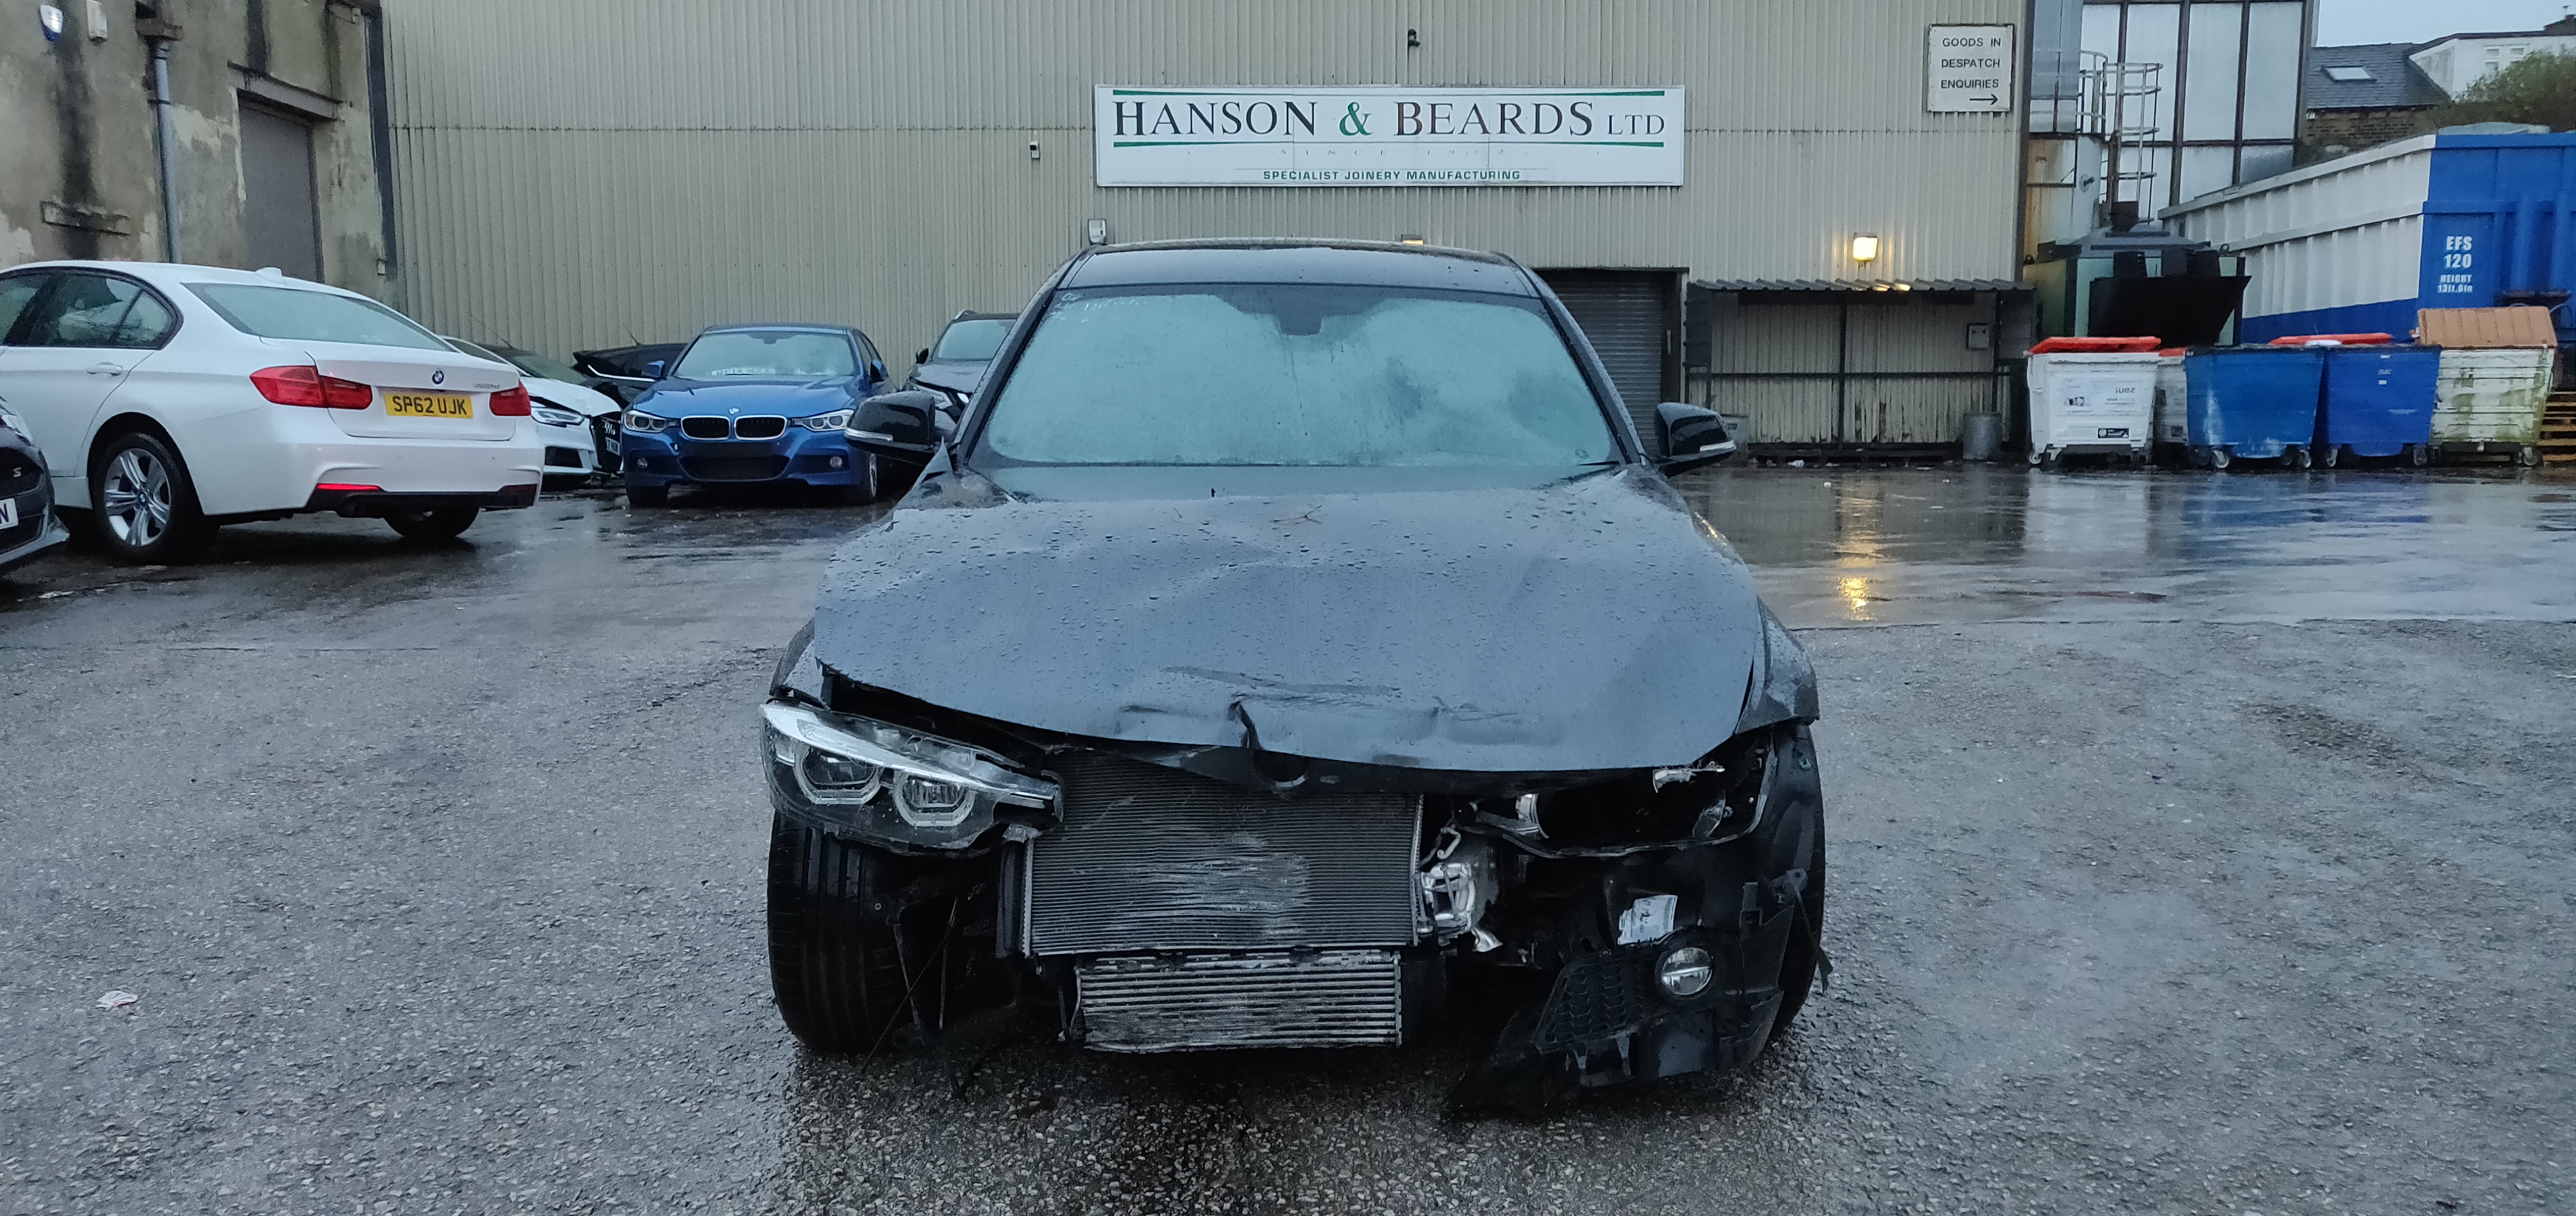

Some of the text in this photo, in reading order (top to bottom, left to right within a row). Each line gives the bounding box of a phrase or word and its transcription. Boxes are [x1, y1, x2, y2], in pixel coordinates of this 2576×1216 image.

[1942, 37, 2001, 47] GOODS IN
[1941, 59, 2000, 68] DESPATCH
[1940, 79, 1999, 89] ENQUIRIES
[1112, 101, 1665, 136] HANSON & BEARDS LTD
[1263, 171, 1520, 180] SPECIALIST JOINERY MANUFACTURING
[2446, 236, 2473, 251] EFS
[2444, 253, 2472, 268] 120
[392, 396, 467, 415] SP62 UJK
